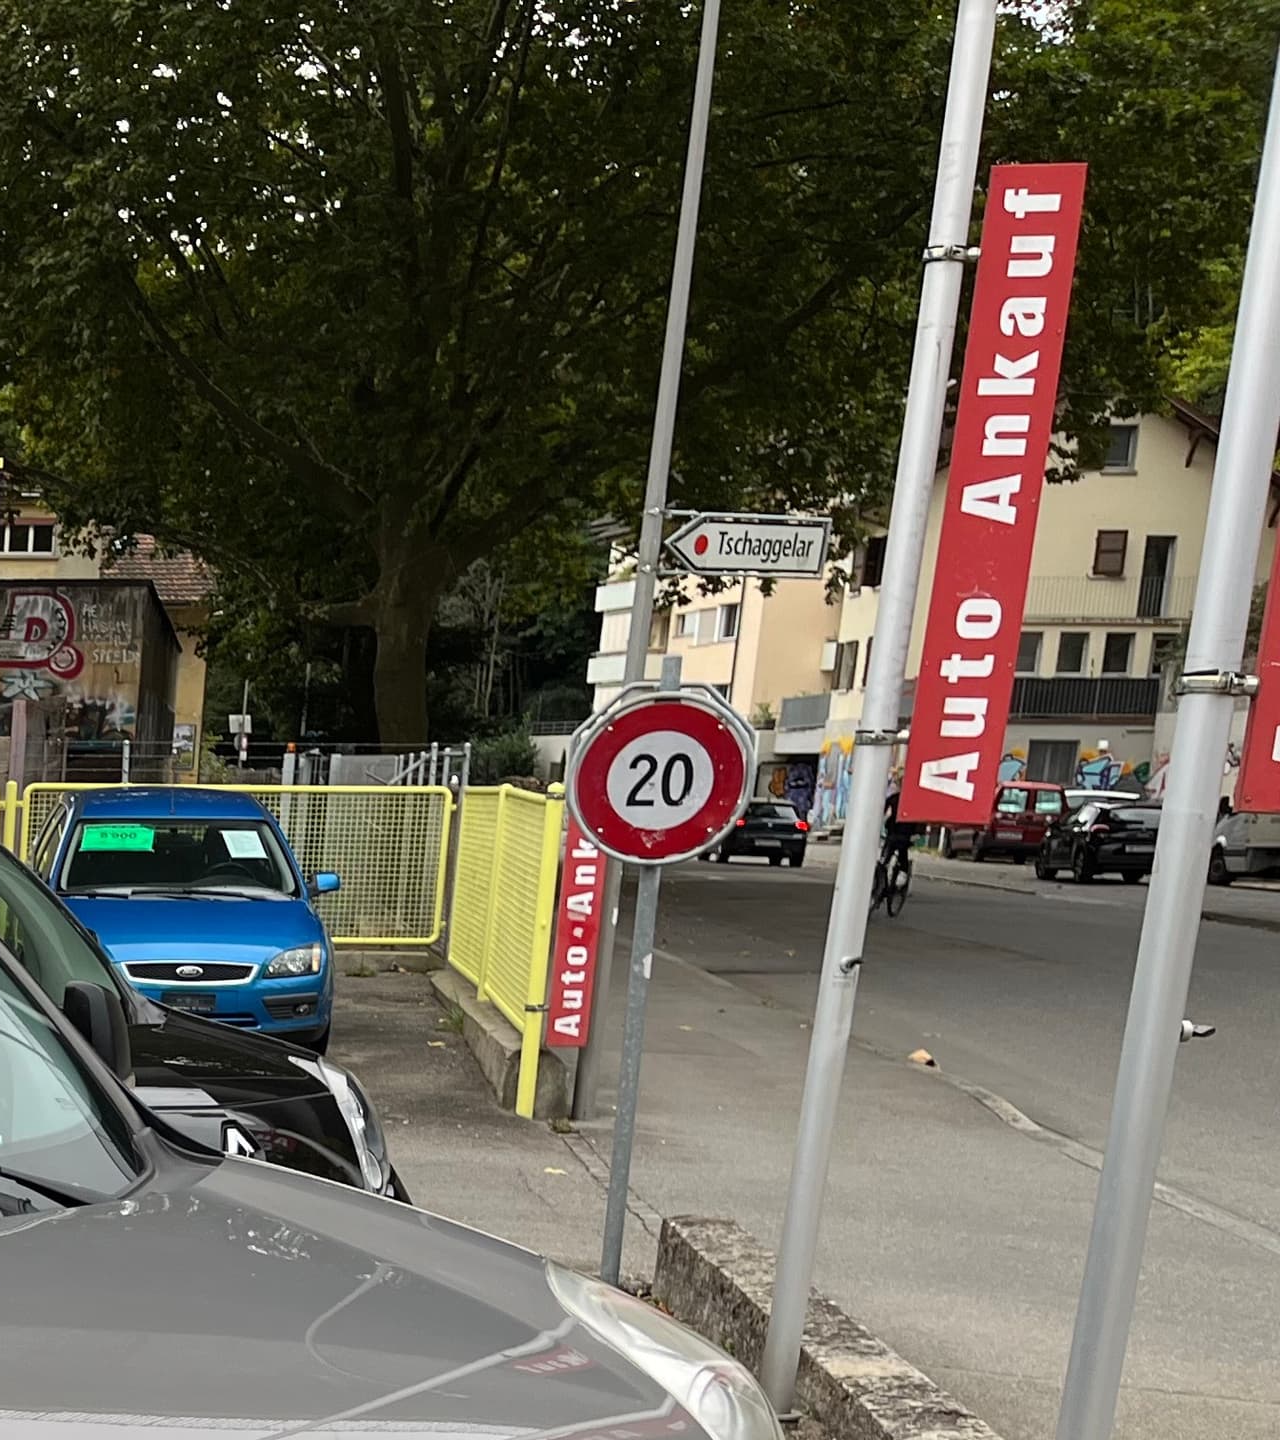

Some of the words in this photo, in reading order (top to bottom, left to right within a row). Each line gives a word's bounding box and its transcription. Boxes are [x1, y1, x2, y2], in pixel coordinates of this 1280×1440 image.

[918, 596, 1004, 802] Auto
[961, 186, 1064, 526] Ankauf
[716, 530, 815, 565] Tschaggelar
[624, 752, 695, 808] 20
[554, 945, 588, 1037] Auto
